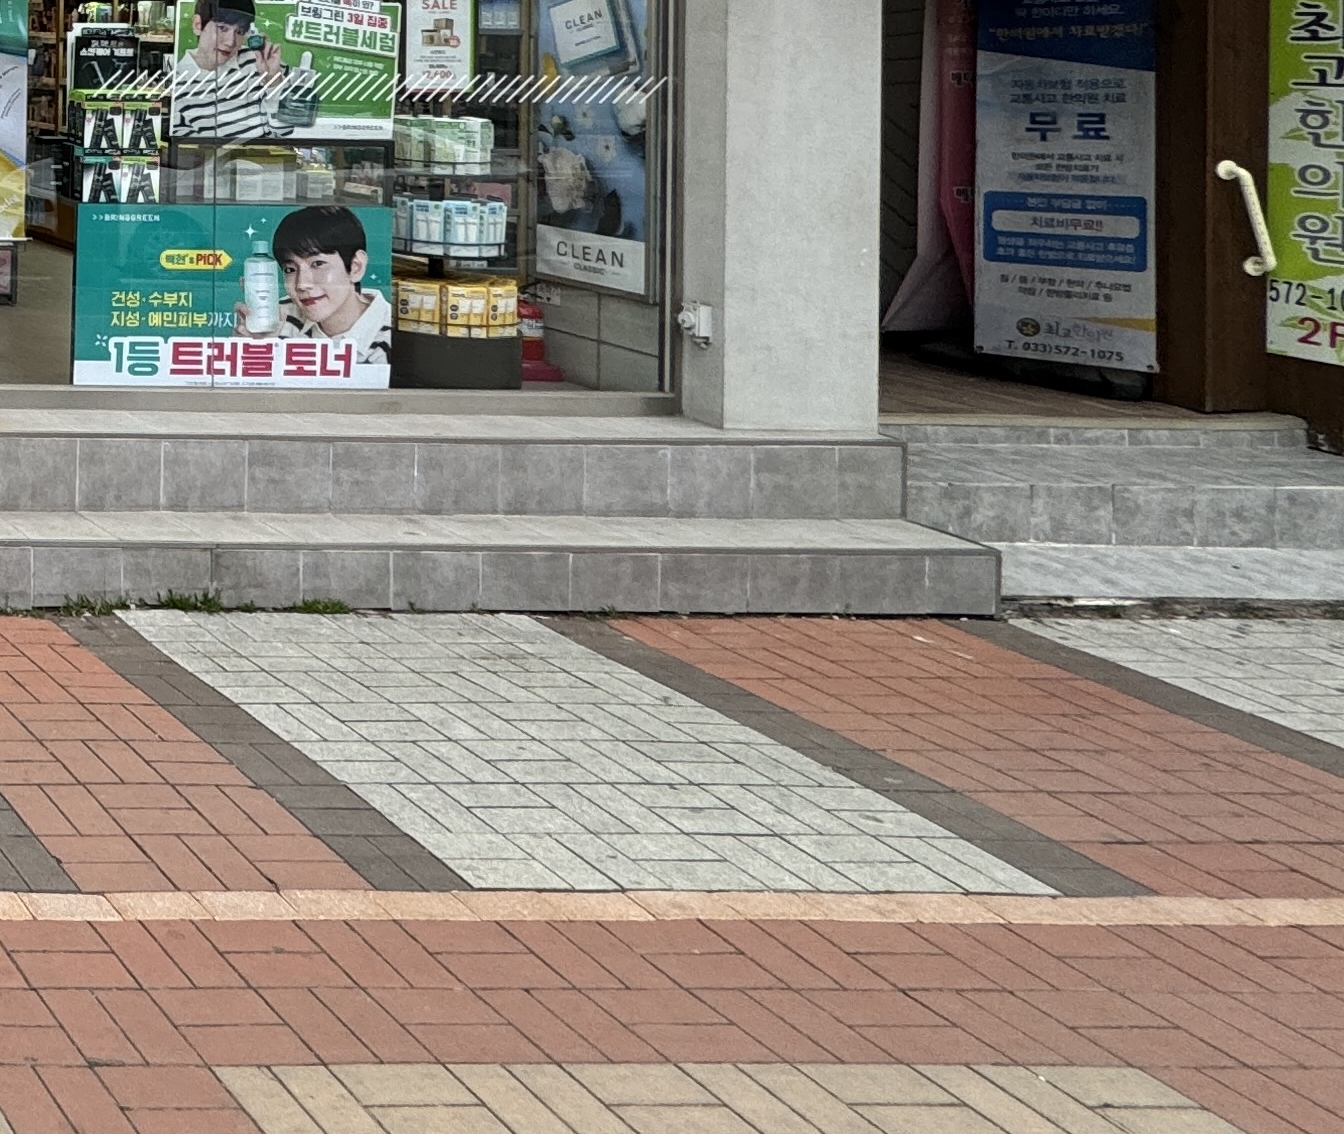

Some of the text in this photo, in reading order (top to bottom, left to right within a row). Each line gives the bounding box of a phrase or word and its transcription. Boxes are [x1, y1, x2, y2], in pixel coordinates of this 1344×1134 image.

[301, 5, 344, 23] 브링그린
[347, 12, 364, 26] 3일
[564, 8, 603, 30] CLEAN
[291, 19, 396, 53] #트러블세럼
[1024, 111, 1112, 142] 무료
[556, 240, 624, 268] CLEAN
[1269, 278, 1344, 312] 572-1
[112, 341, 354, 379] 1등 트러블 토너
